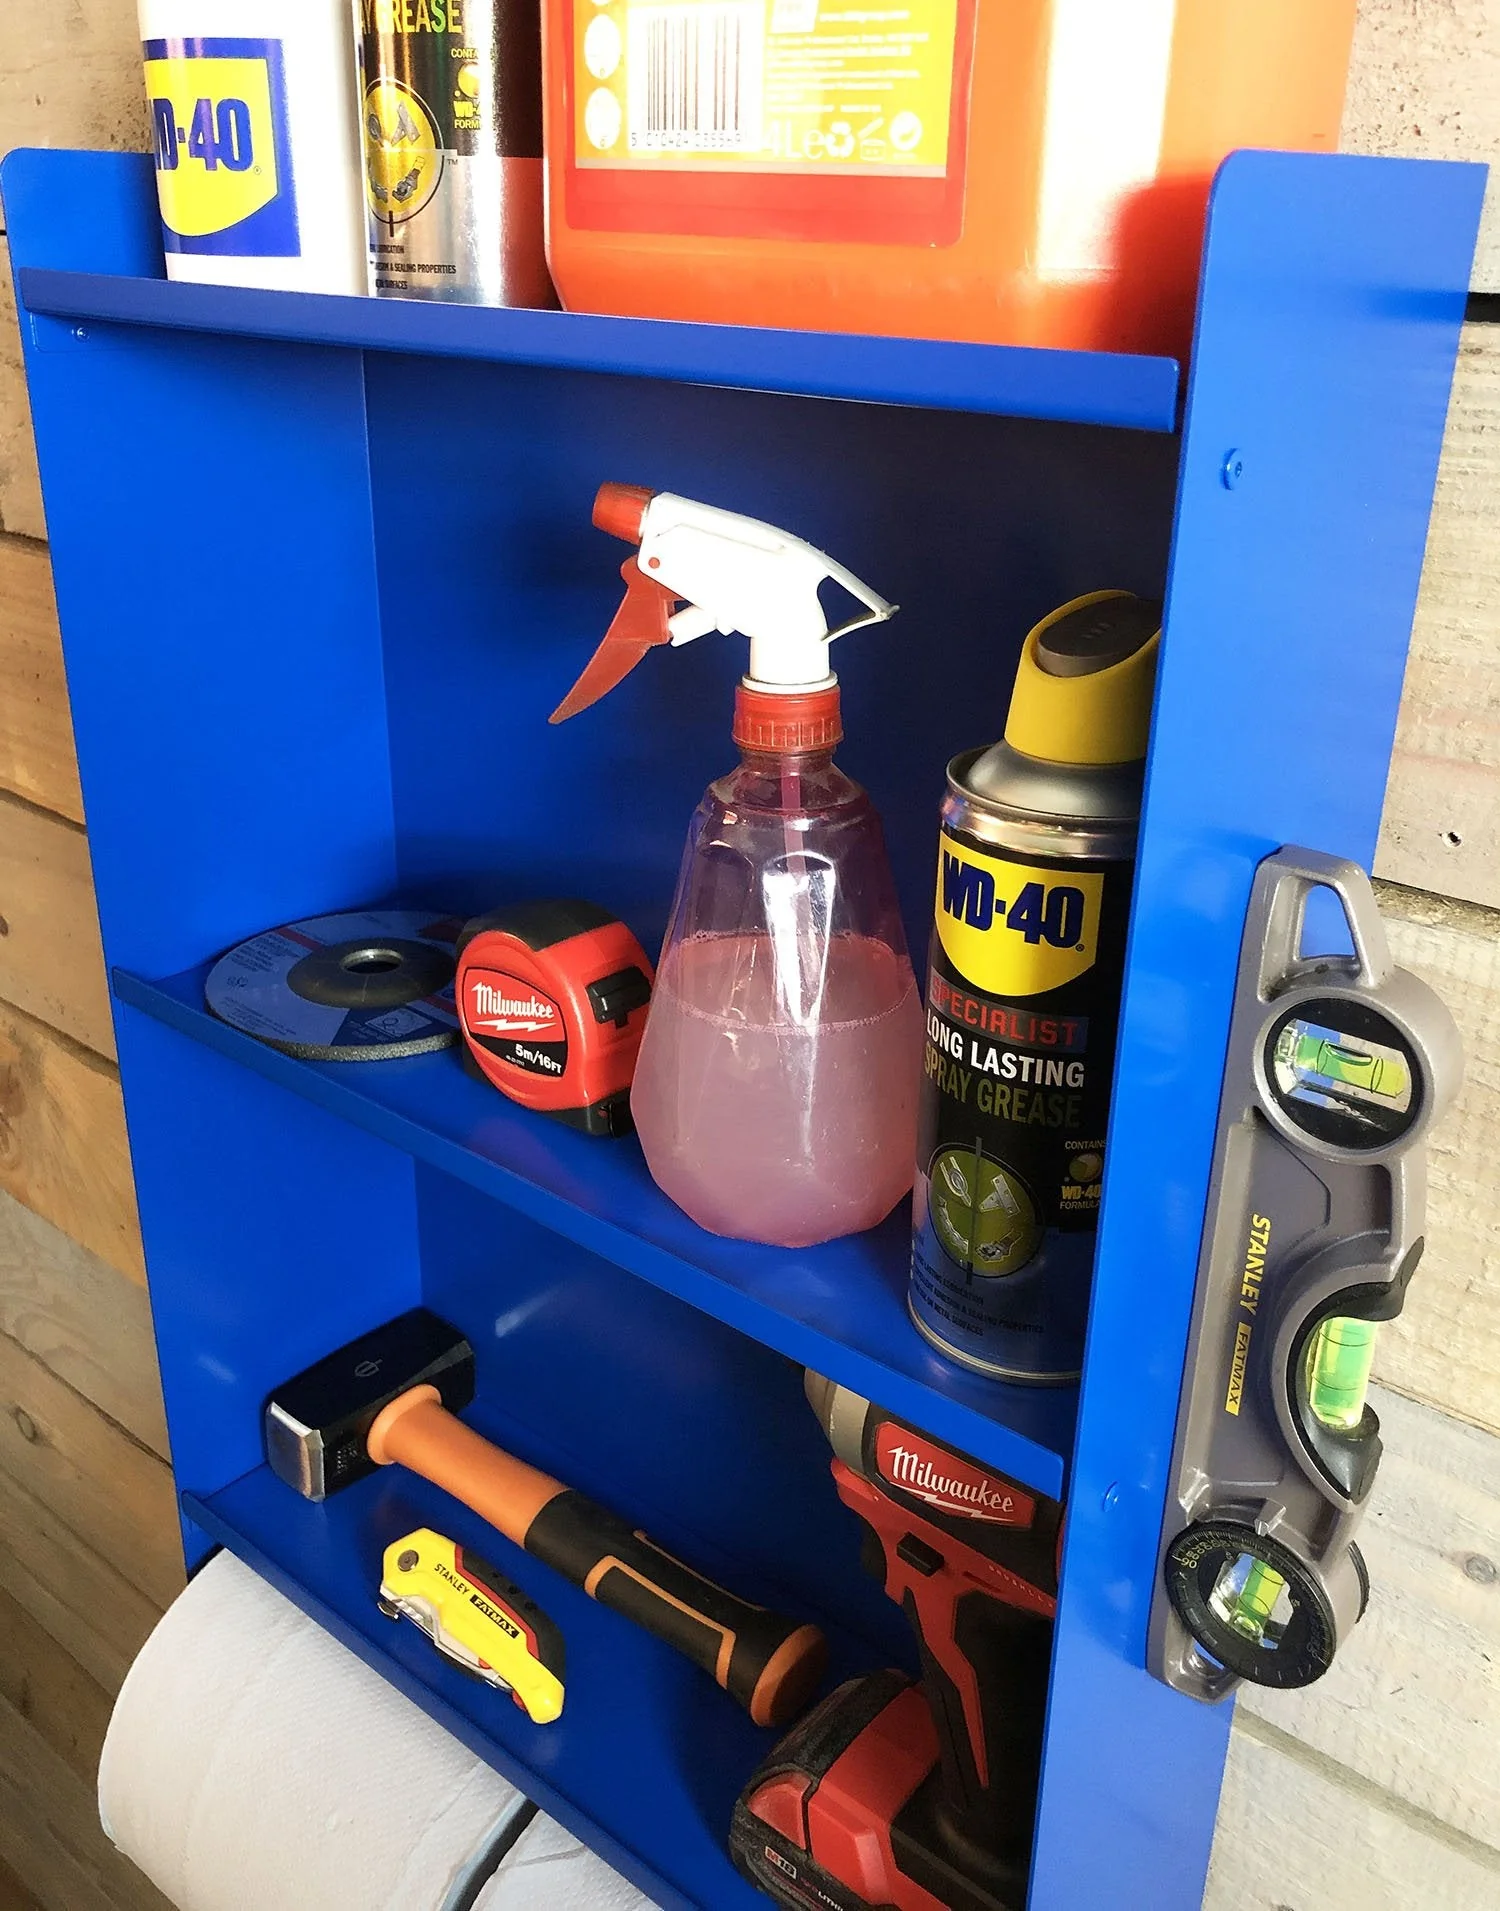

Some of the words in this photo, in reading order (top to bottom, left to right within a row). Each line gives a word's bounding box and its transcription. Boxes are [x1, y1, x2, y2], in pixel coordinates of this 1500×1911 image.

[152, 98, 253, 171] D-40
[418, 265, 456, 274] PROPERTIES
[941, 852, 1083, 949] WD-40
[471, 981, 555, 1019] Milwaukee
[931, 975, 1078, 1046] SPECIALIST
[924, 1040, 972, 1104] SPRAY
[977, 1078, 1082, 1128] GREASE
[926, 1008, 964, 1061] LONG
[970, 1040, 1085, 1088] LASTING
[1239, 1213, 1271, 1316] STANLEY
[1228, 1332, 1249, 1405] FATMAX
[887, 1446, 1014, 1512] Milwaukee
[434, 1563, 470, 1595] STANLEY
[474, 1598, 516, 1636] FATMAX
[766, 1847, 795, 1875] M18
